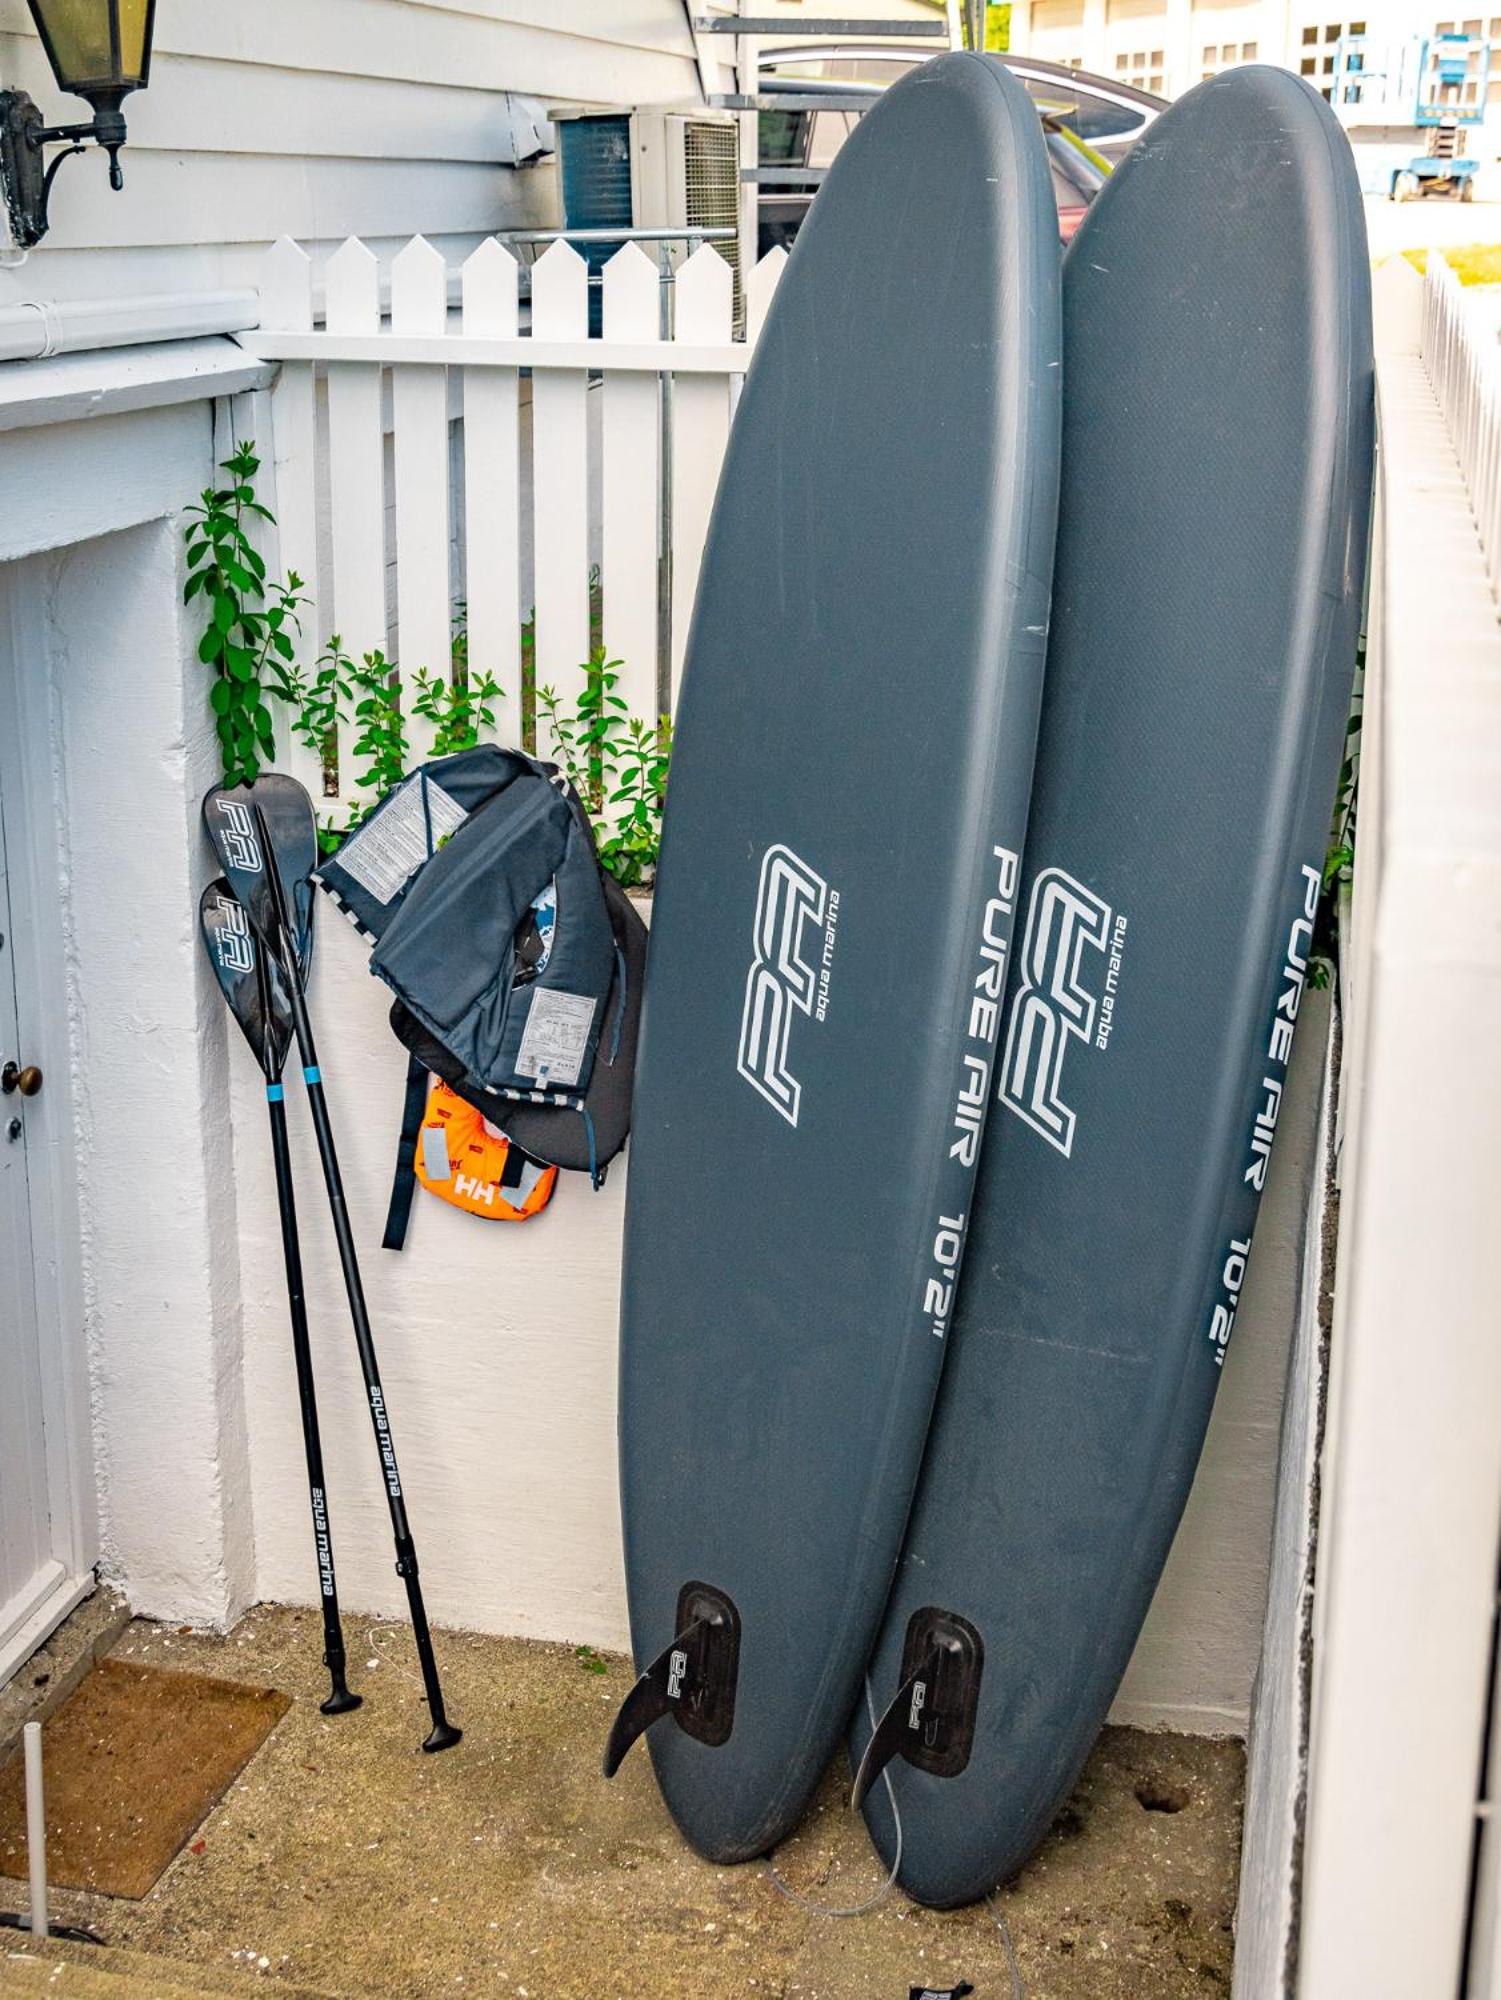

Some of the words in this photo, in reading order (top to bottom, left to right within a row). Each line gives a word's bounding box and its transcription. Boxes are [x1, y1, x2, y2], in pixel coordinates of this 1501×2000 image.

[822, 889, 840, 969] marina
[968, 845, 1019, 1044] PURE
[1104, 915, 1128, 994] marina
[1267, 863, 1322, 1065] PURE
[815, 970, 831, 1022] aqua
[1096, 996, 1115, 1050] aqua
[950, 1054, 988, 1168] AIR
[1244, 1077, 1282, 1191] AIR
[454, 1174, 496, 1206] HH
[923, 1213, 965, 1338] 10'2"
[1208, 1238, 1251, 1366] 10'2"
[370, 1385, 388, 1430] aqua
[379, 1433, 401, 1497] marina
[312, 1487, 327, 1530] aqua
[316, 1533, 334, 1597] marina
